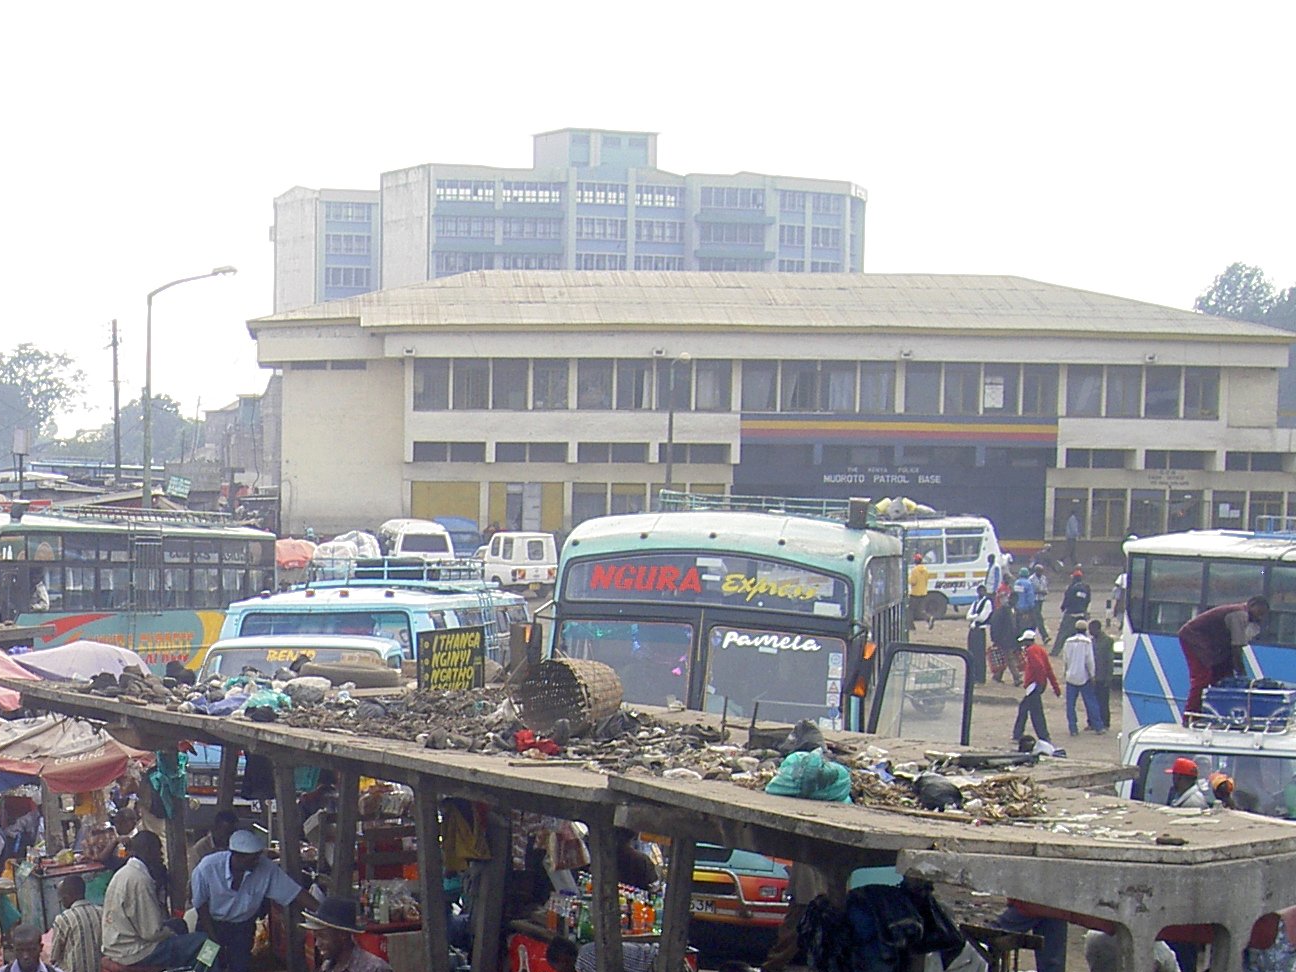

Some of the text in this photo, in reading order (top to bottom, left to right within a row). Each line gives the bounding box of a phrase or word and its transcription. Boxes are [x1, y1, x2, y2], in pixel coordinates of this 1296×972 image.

[873, 474, 910, 483] PATROL
[918, 475, 942, 484] BASE
[590, 563, 702, 593] NGURA
[722, 630, 822, 652] Pamela
